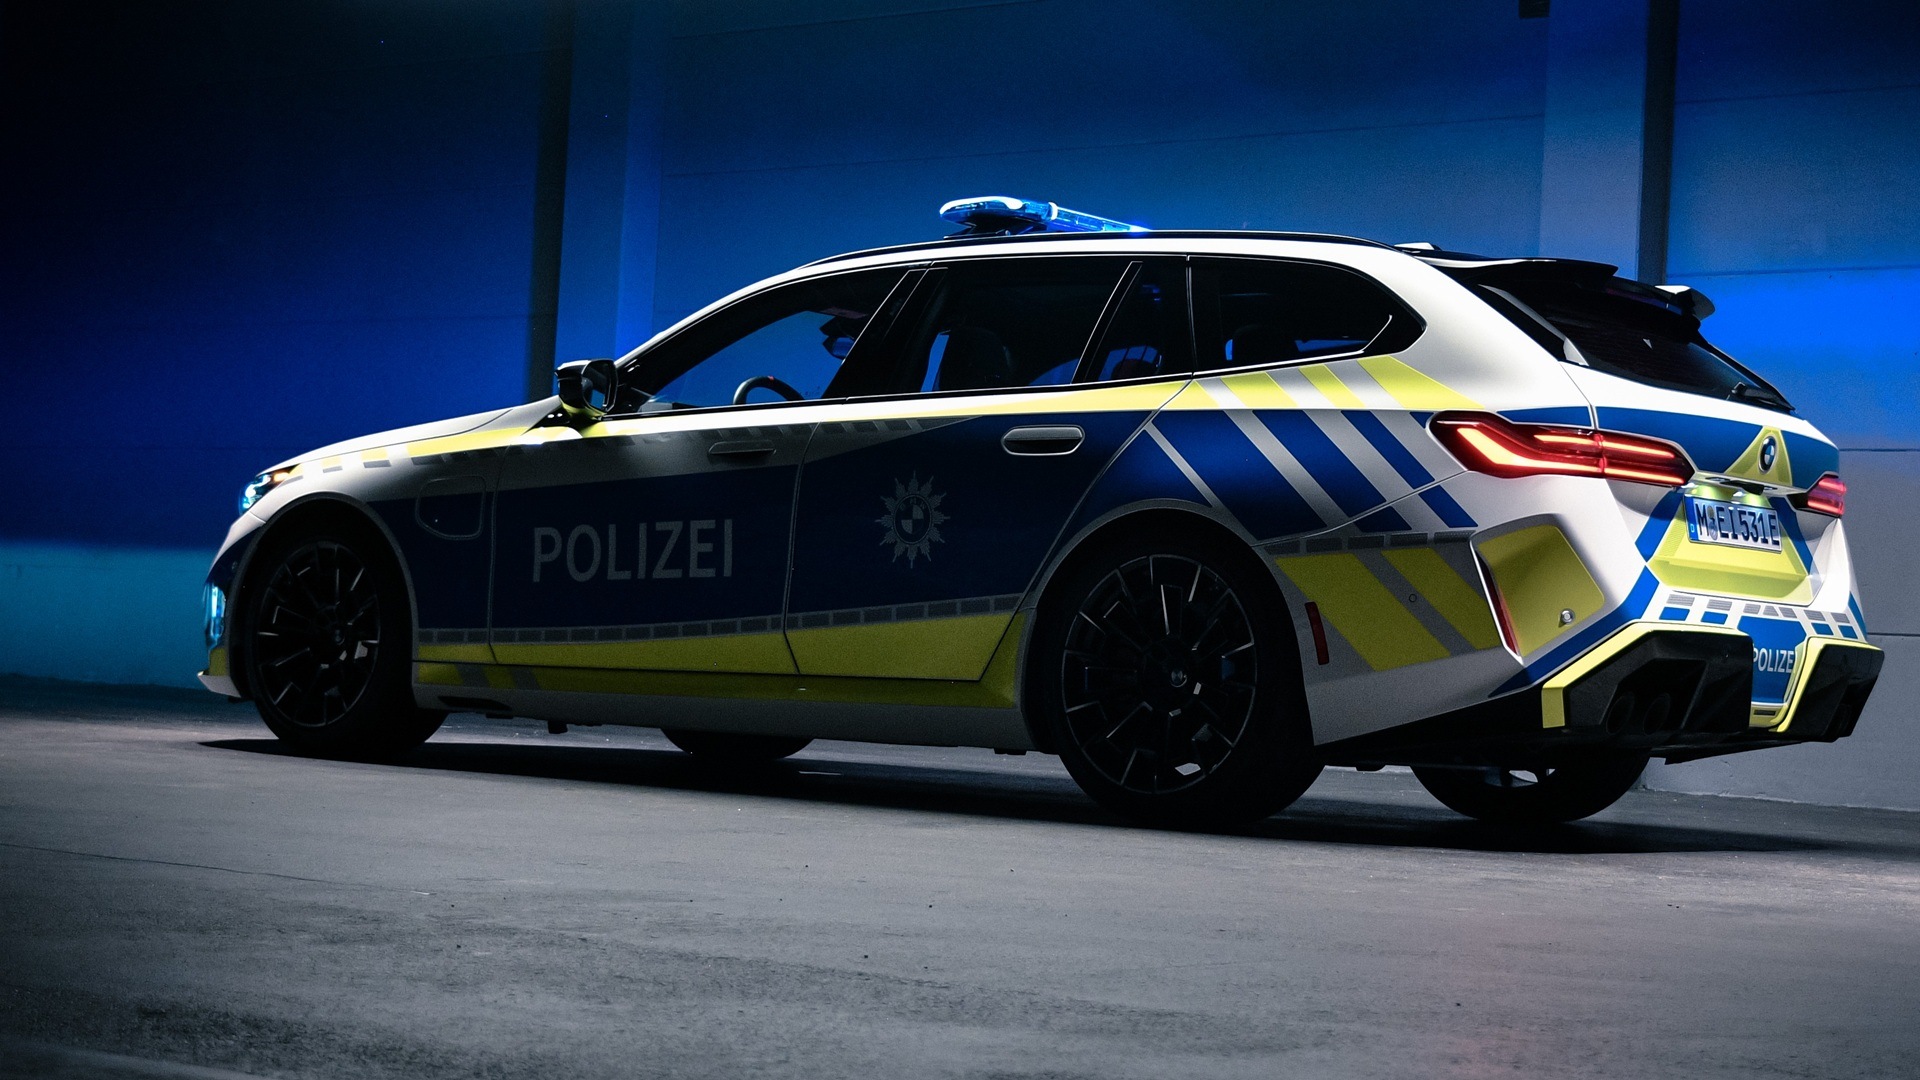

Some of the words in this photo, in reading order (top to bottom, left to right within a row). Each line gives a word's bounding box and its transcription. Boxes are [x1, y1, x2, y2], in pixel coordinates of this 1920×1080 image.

[1695, 503, 1709, 536] M
[532, 519, 733, 582] POLIZEI
[1753, 647, 1795, 673] POLIZE
